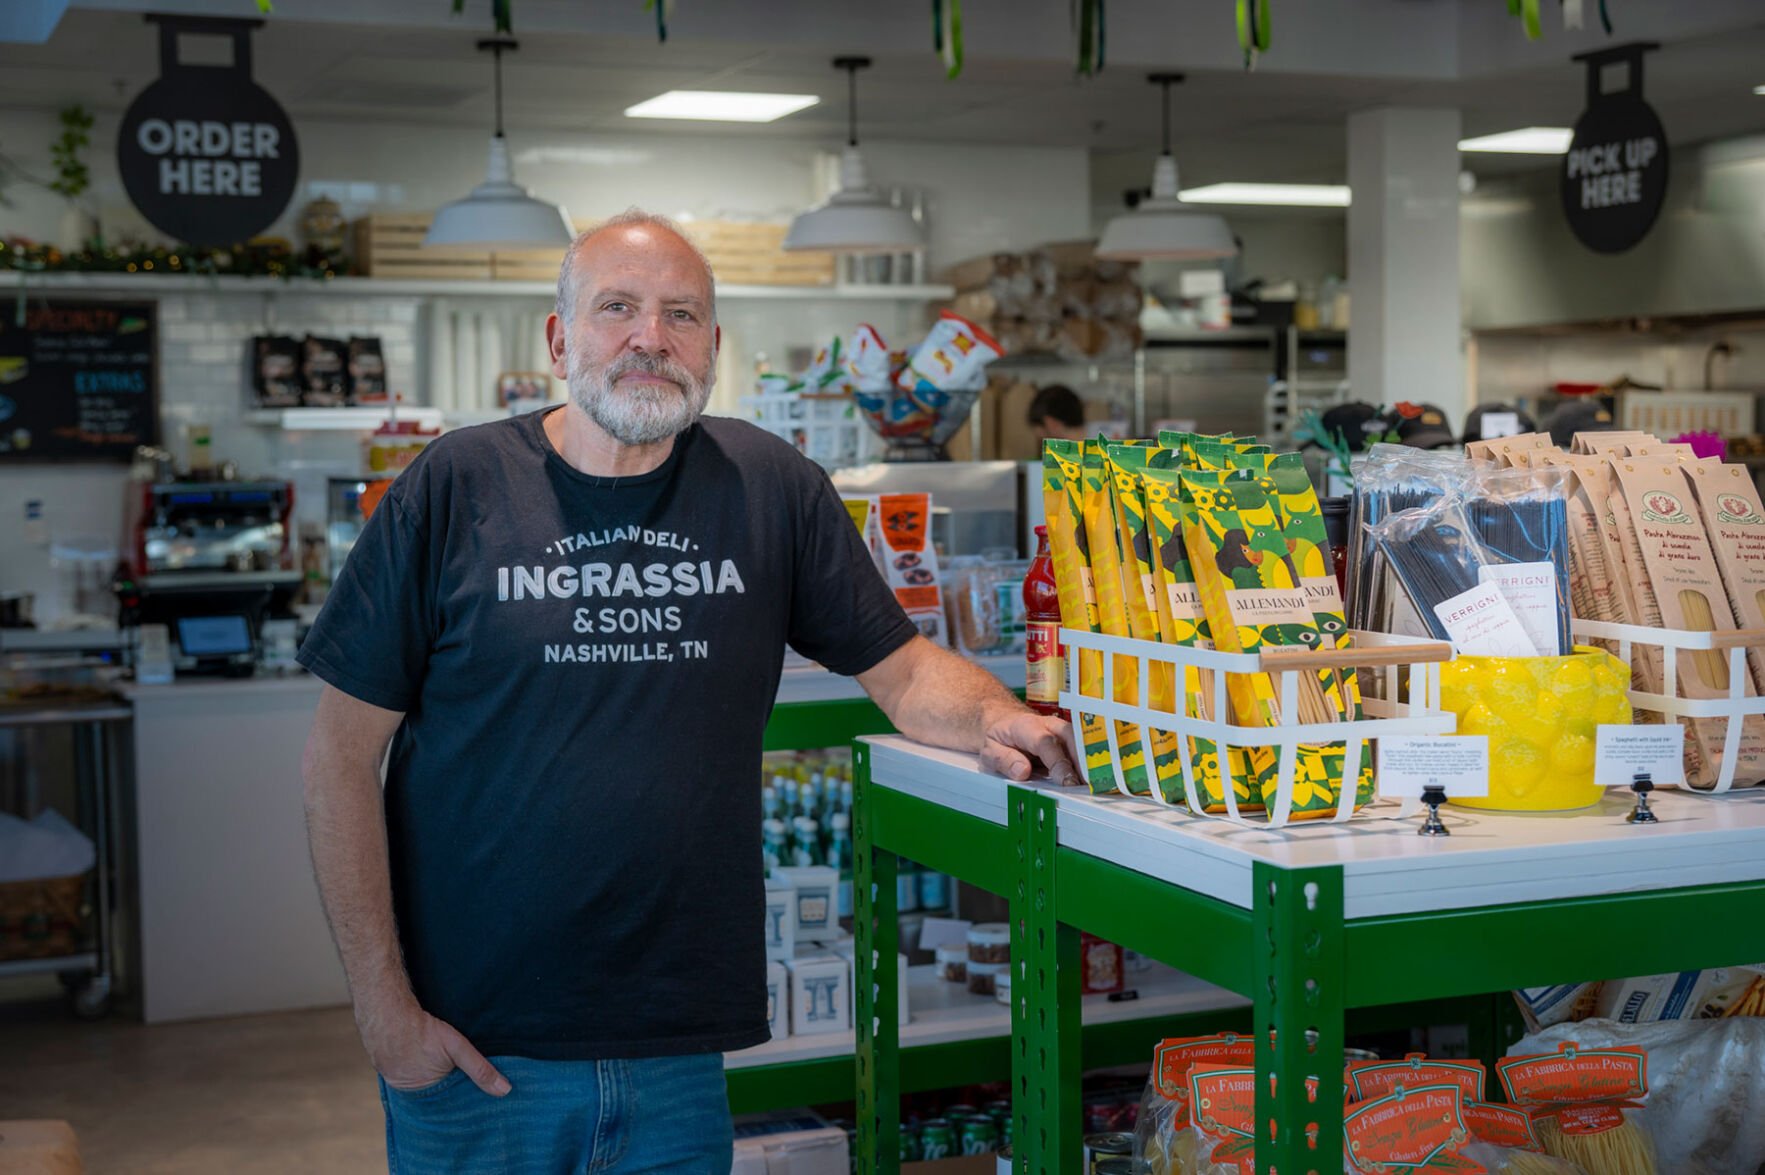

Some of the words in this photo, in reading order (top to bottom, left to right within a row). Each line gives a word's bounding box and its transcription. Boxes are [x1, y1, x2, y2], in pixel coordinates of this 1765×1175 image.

[137, 118, 280, 158] ORDER
[1567, 142, 1621, 178] PICK
[1625, 136, 1658, 169] UP
[159, 158, 262, 196] HERE
[1581, 170, 1641, 209] HERE
[555, 525, 641, 556] ITALIAN
[643, 529, 690, 552] DELI
[497, 559, 746, 601] INGRASSIA
[1495, 576, 1550, 587] RRIGNI
[1236, 597, 1305, 610] ALLEMANDI
[1444, 593, 1499, 624] VERRIGNI
[573, 607, 594, 634] &
[599, 606, 682, 634] SONS
[544, 643, 674, 663] NASHVILLE,
[680, 640, 708, 659] TN
[1181, 1047, 1228, 1059] FABBRICA
[1525, 1062, 1575, 1078] FABBRICA
[1576, 1063, 1599, 1071] DELLA
[1602, 1059, 1634, 1071] PASTA
[1219, 1079, 1254, 1092] FABBR
[1351, 1126, 1361, 1136] LA
[1360, 1106, 1404, 1129] FABBRICA
[1405, 1102, 1425, 1113] DELLA
[1426, 1094, 1452, 1108] PASTA
[1495, 1111, 1523, 1127] PASTA
